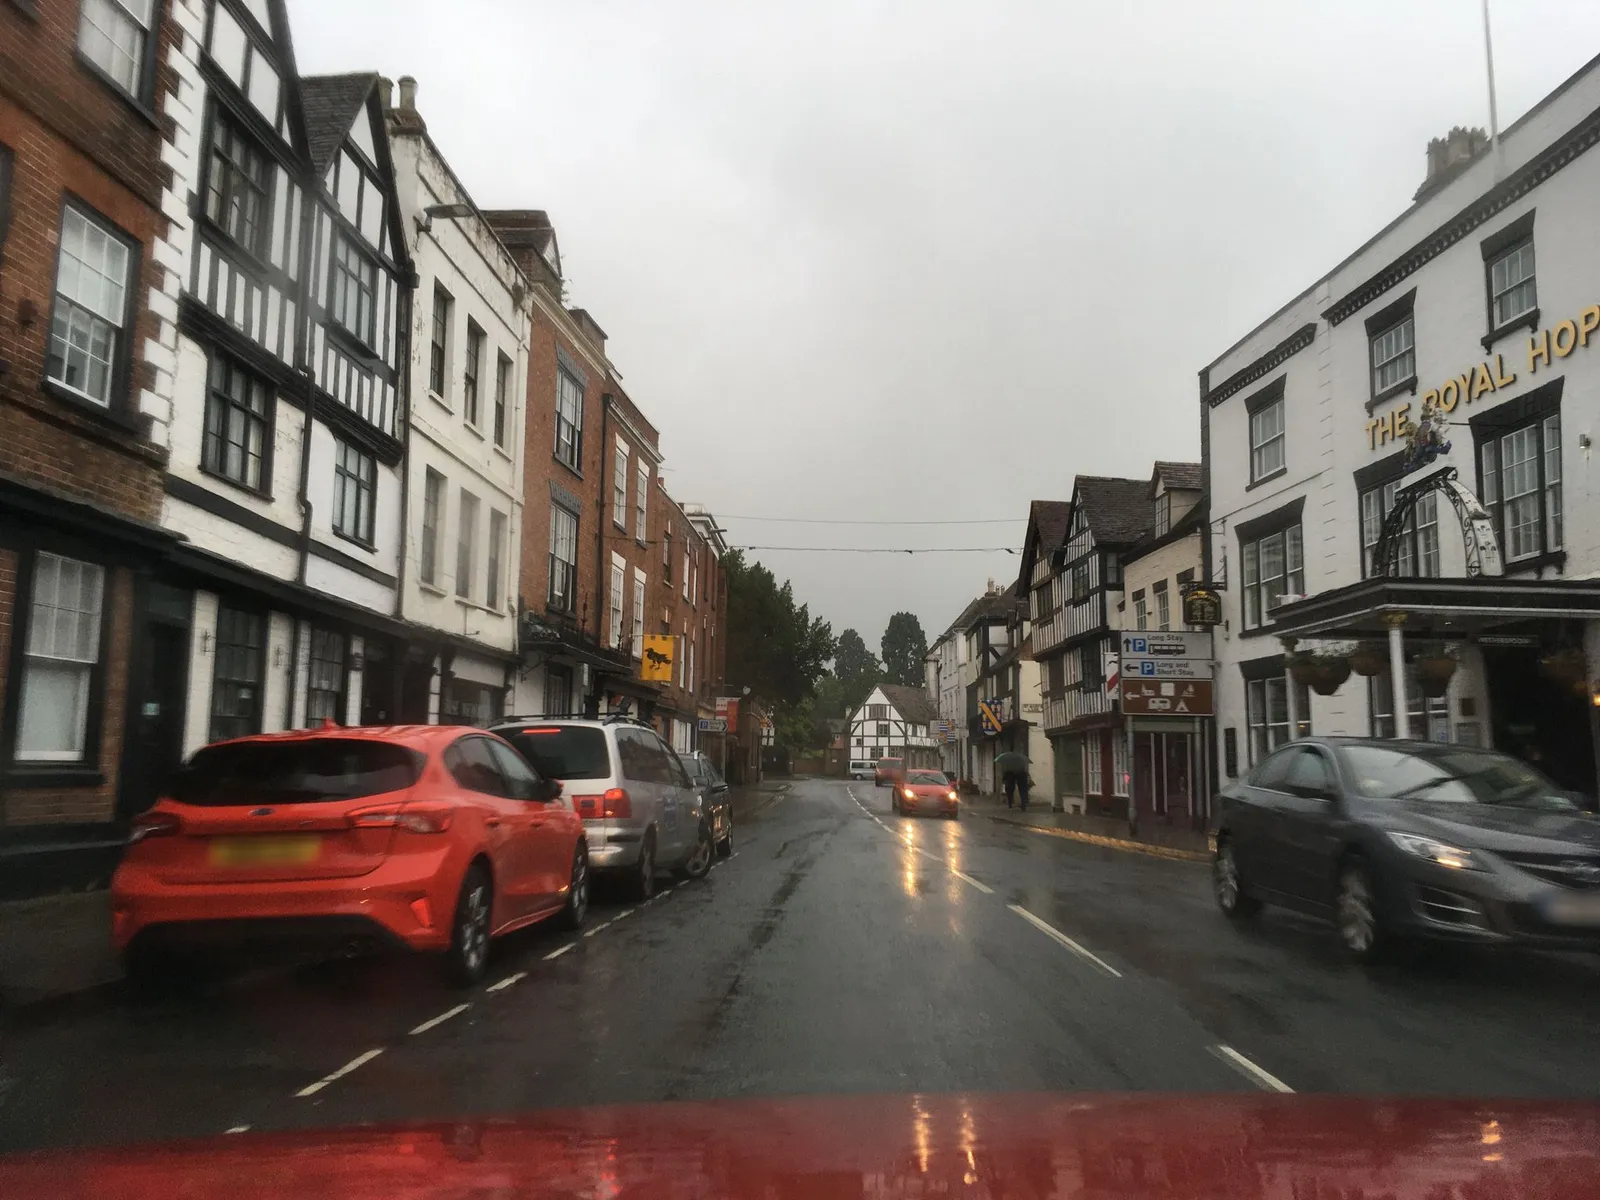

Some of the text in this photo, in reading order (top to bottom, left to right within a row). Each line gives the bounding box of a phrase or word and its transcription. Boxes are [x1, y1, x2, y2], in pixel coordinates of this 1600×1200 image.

[1365, 403, 1411, 450] THE
[1528, 304, 1600, 373] HOP
[1147, 634, 1164, 642] Long
[1166, 634, 1183, 642] Stay
